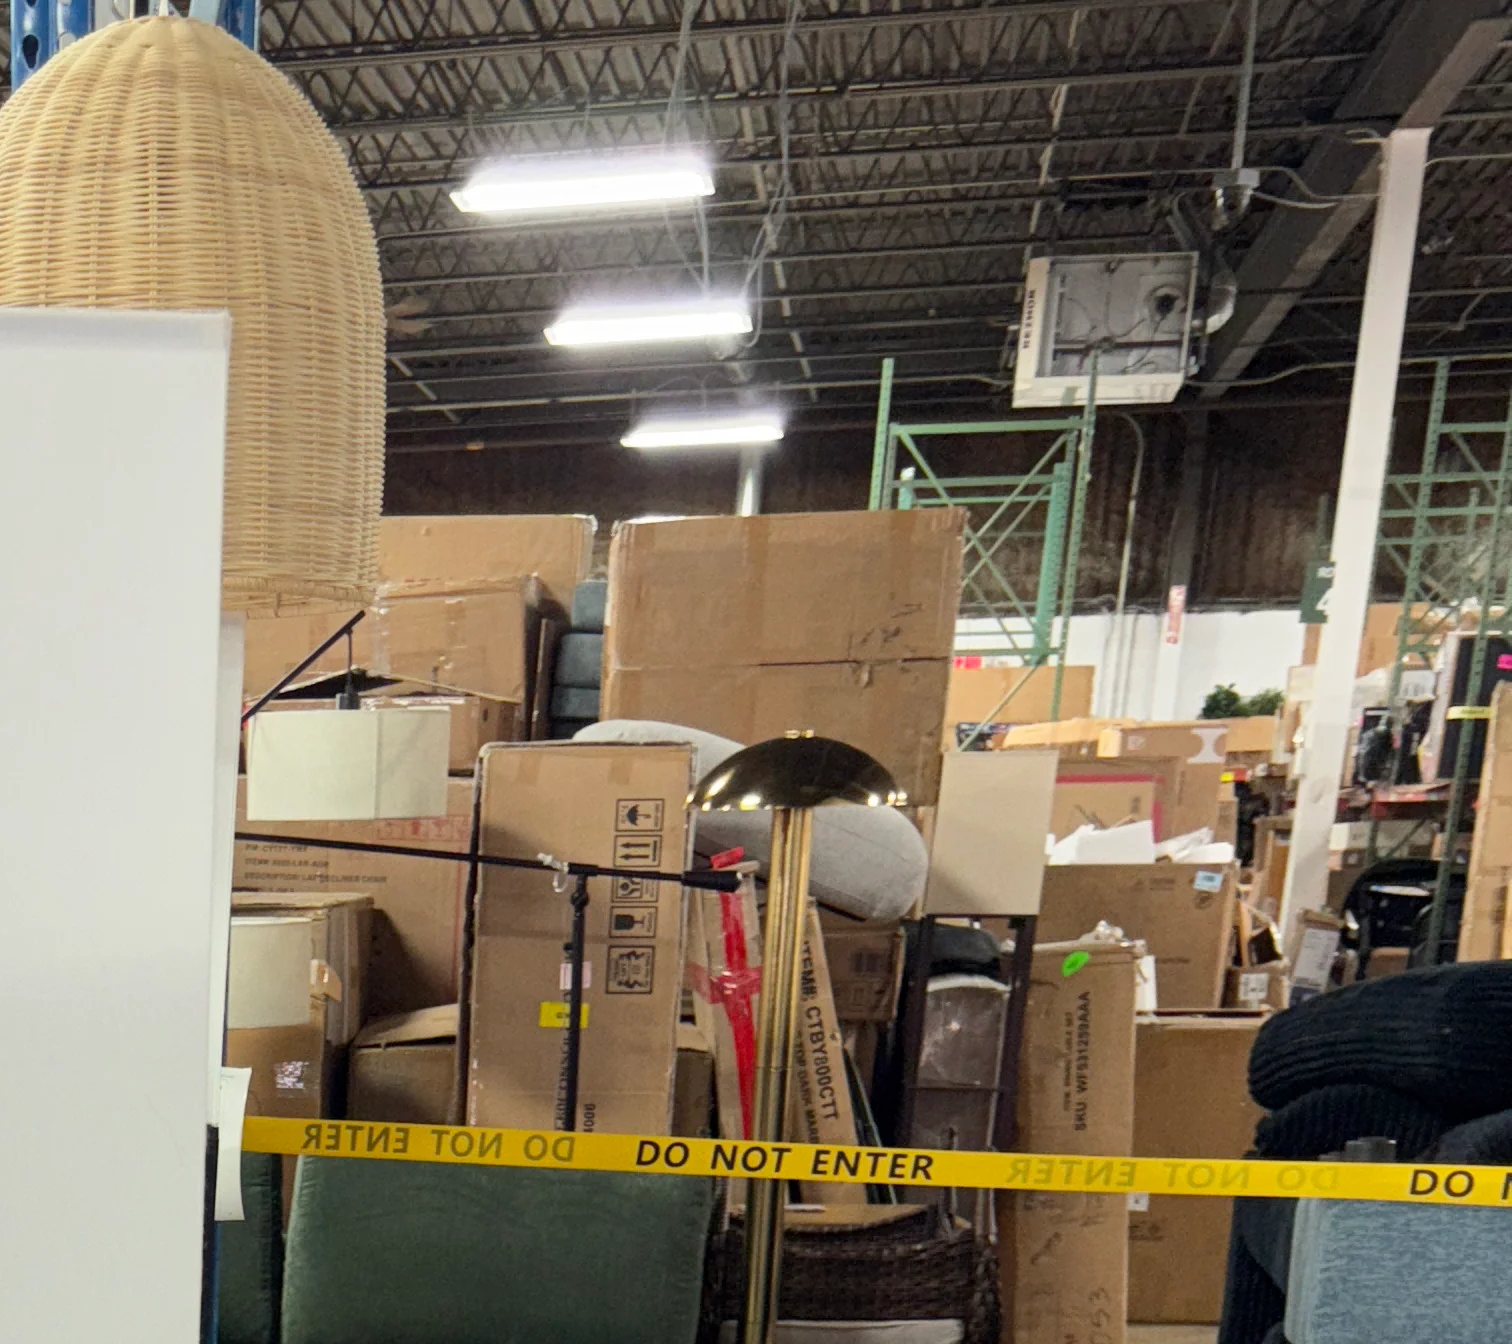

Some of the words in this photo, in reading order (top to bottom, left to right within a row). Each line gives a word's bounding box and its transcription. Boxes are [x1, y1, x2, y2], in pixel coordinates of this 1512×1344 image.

[636, 1140, 690, 1168] DO
[710, 1144, 792, 1173] NOT
[810, 1149, 934, 1181] ENTER
[1409, 1169, 1475, 1198] DO
